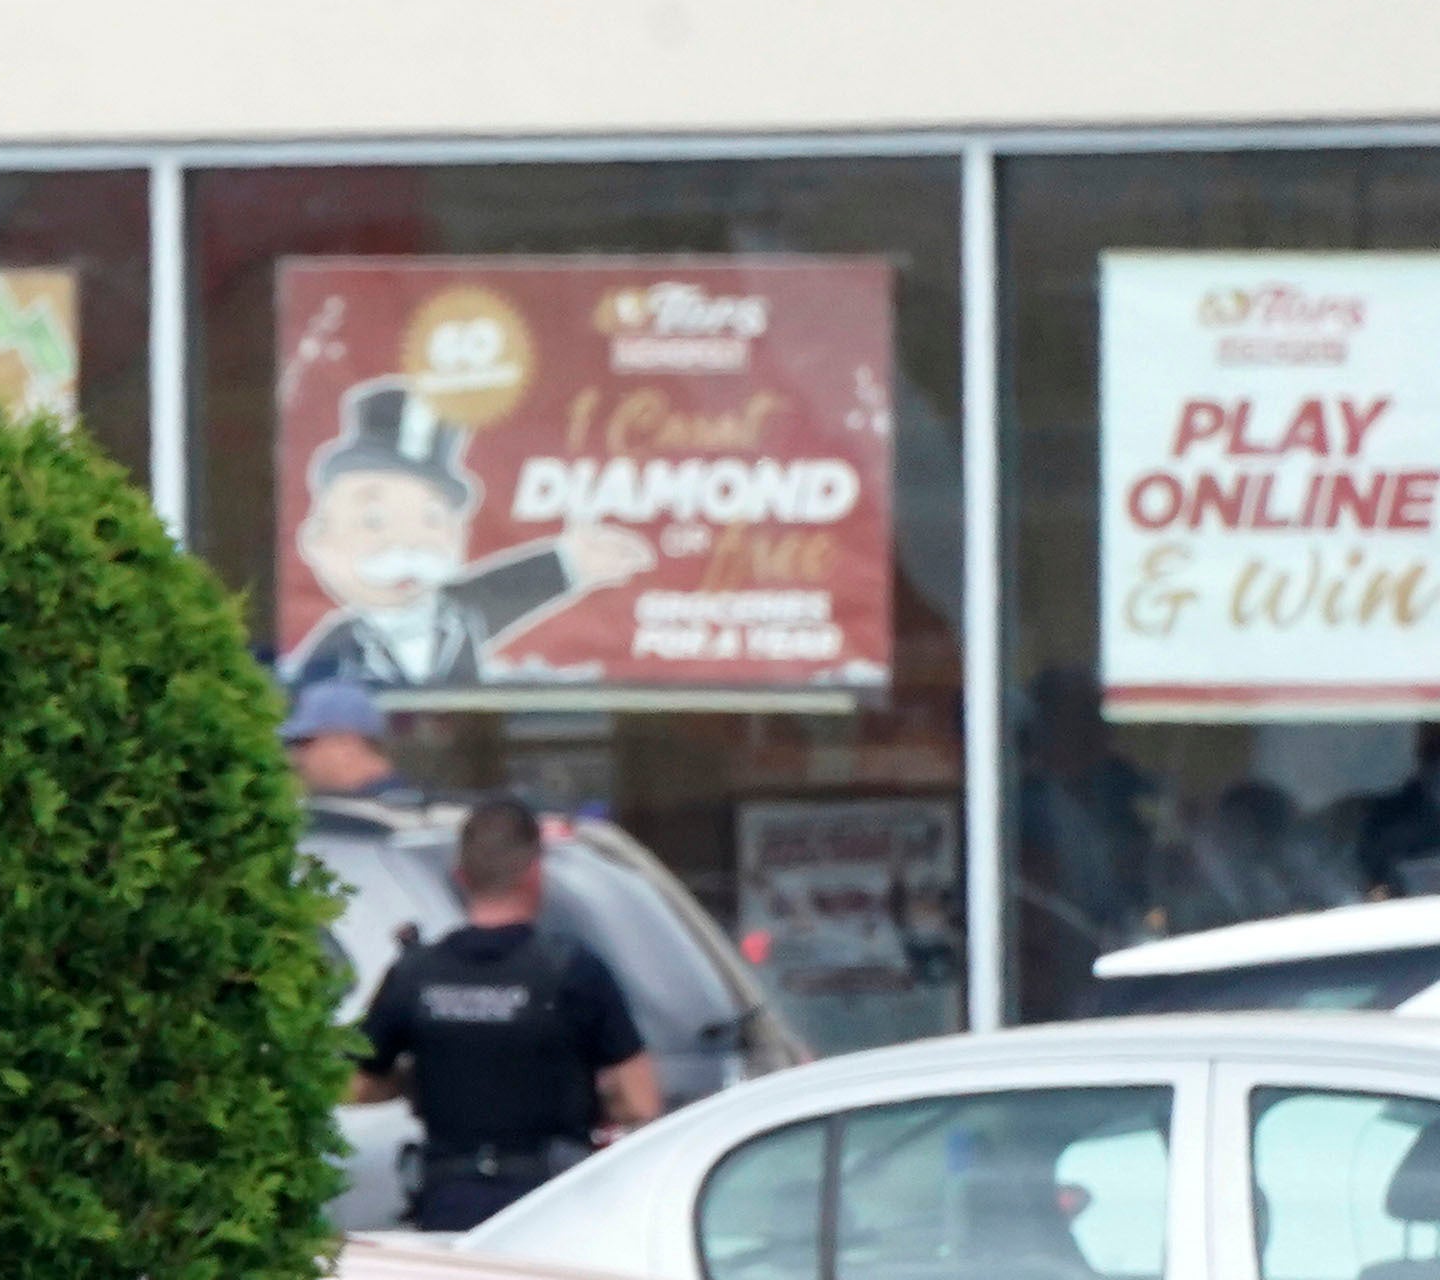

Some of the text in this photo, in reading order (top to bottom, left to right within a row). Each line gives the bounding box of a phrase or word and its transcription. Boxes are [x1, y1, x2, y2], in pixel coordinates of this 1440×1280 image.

[1173, 394, 1390, 458] PLAY
[511, 457, 861, 524] DIAMOND
[1127, 472, 1440, 530] ONLINE
[1125, 542, 1200, 638] &
